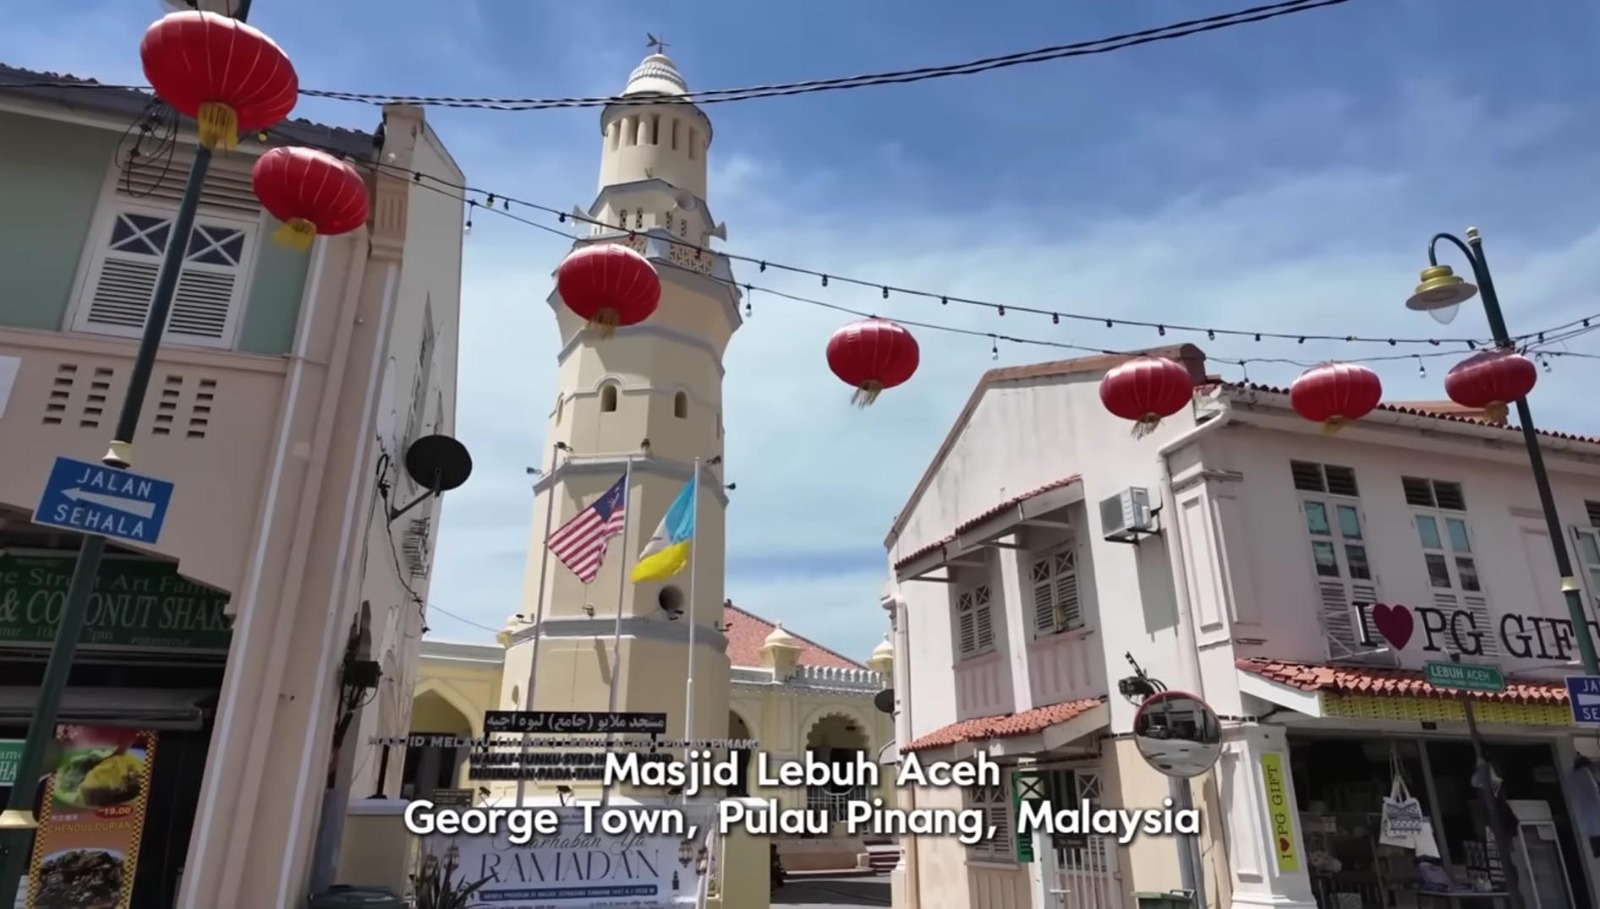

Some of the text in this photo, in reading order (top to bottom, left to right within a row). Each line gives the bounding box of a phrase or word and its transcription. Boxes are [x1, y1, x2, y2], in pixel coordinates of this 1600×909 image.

[76, 468, 152, 498] JALAN
[54, 503, 145, 538] SEHALA
[28, 567, 102, 589] Strt
[110, 574, 150, 592] Art
[0, 588, 231, 631] & COONUT SHAK
[1352, 601, 1379, 648] I
[1414, 606, 1485, 656] PG
[1430, 664, 1491, 682] LEBUH ACEH
[1583, 679, 1600, 692] JA
[430, 735, 490, 749] MELAYU
[1266, 764, 1284, 806] GIFT
[1274, 812, 1289, 836] PG
[492, 829, 602, 852] arhaban
[480, 849, 661, 884] RAMADAN
